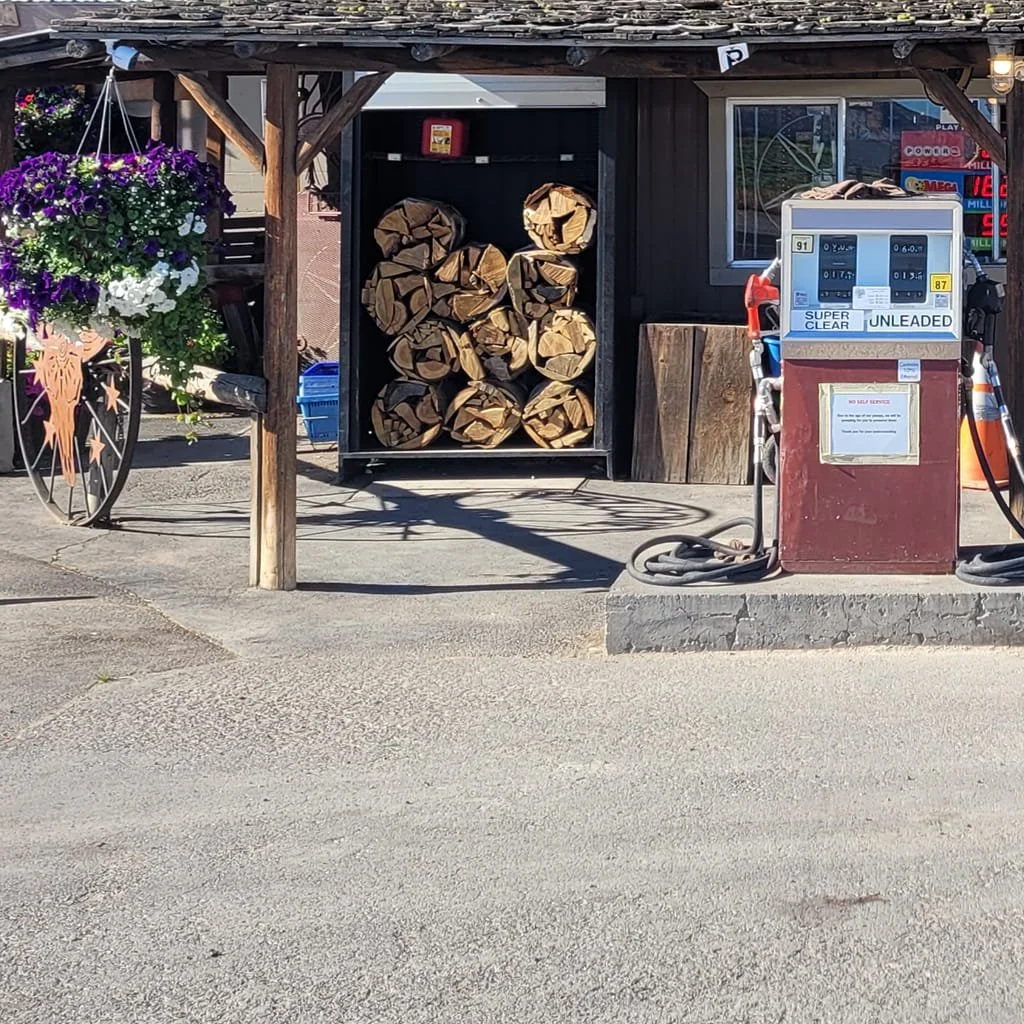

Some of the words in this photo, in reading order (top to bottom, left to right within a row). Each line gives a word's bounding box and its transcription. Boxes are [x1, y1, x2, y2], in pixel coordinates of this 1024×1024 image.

[796, 241, 808, 251] 91
[935, 280, 947, 290] 87
[805, 311, 850, 320] SUPER
[805, 321, 849, 330] CLEAR
[869, 315, 952, 327] UNLEADED
